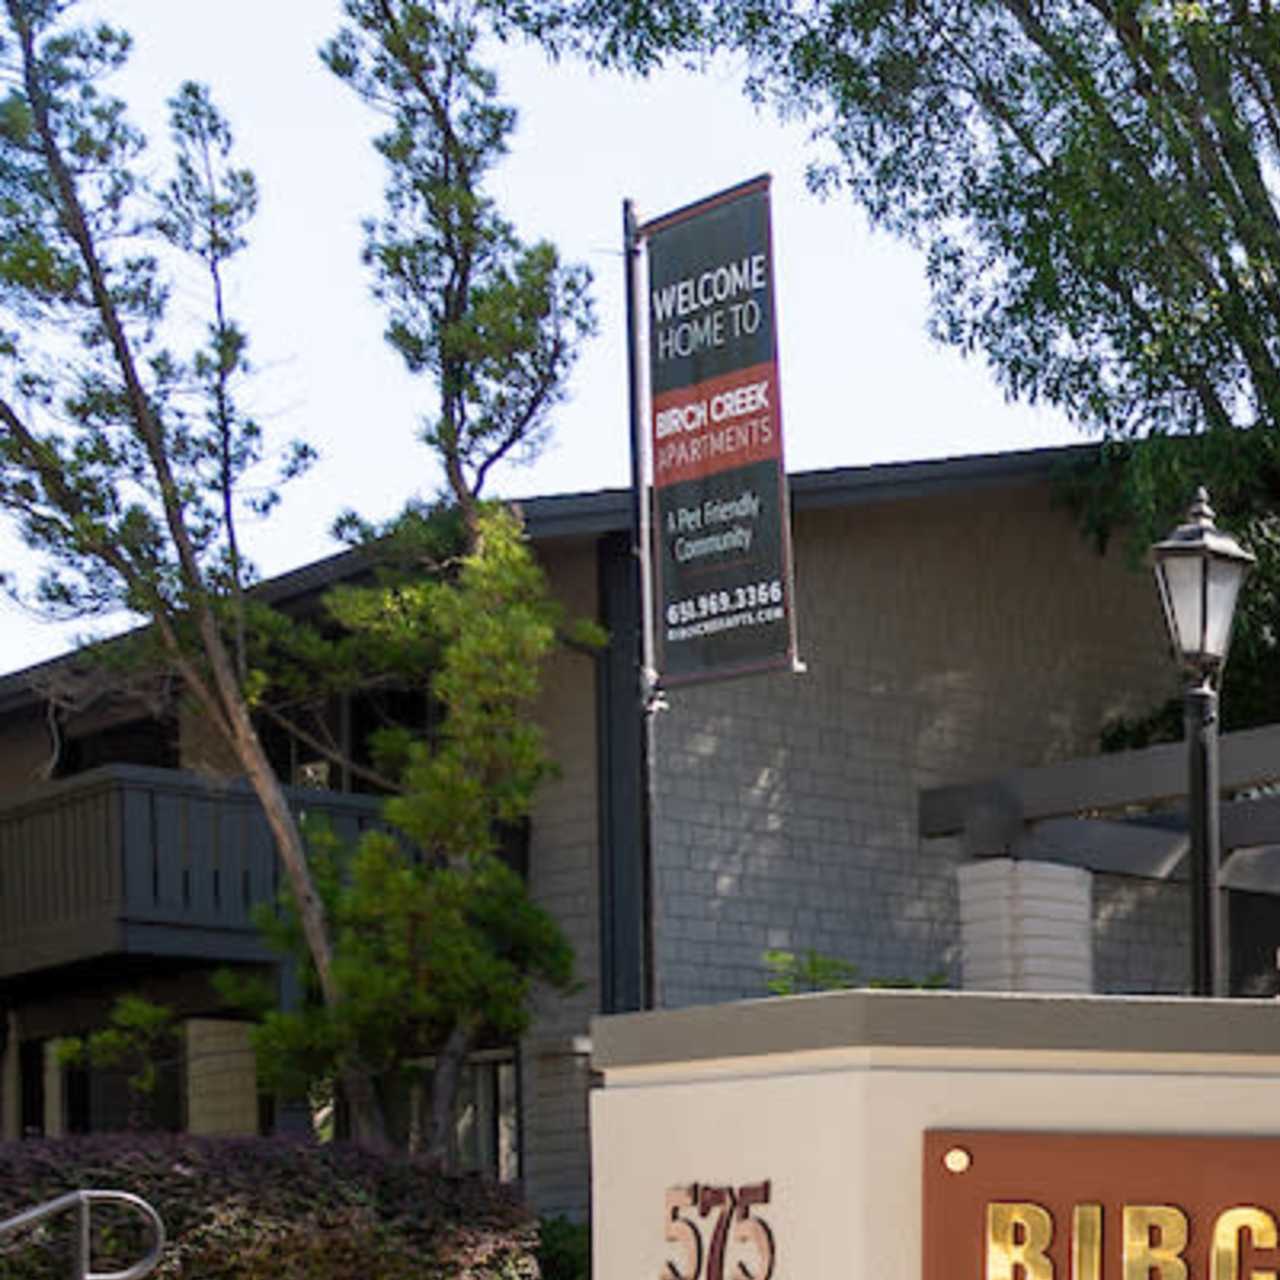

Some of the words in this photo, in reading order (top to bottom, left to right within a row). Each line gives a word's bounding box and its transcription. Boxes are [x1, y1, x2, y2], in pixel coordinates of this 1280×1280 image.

[653, 255, 766, 322] WELCOME
[658, 310, 725, 360] HOME
[730, 299, 760, 338] TO
[656, 400, 708, 439] BIRCH
[711, 380, 769, 422] CREEK
[657, 416, 772, 471] APARTMENTS
[677, 508, 701, 531] Pet
[704, 490, 760, 525] Friendly
[675, 525, 751, 562] Community
